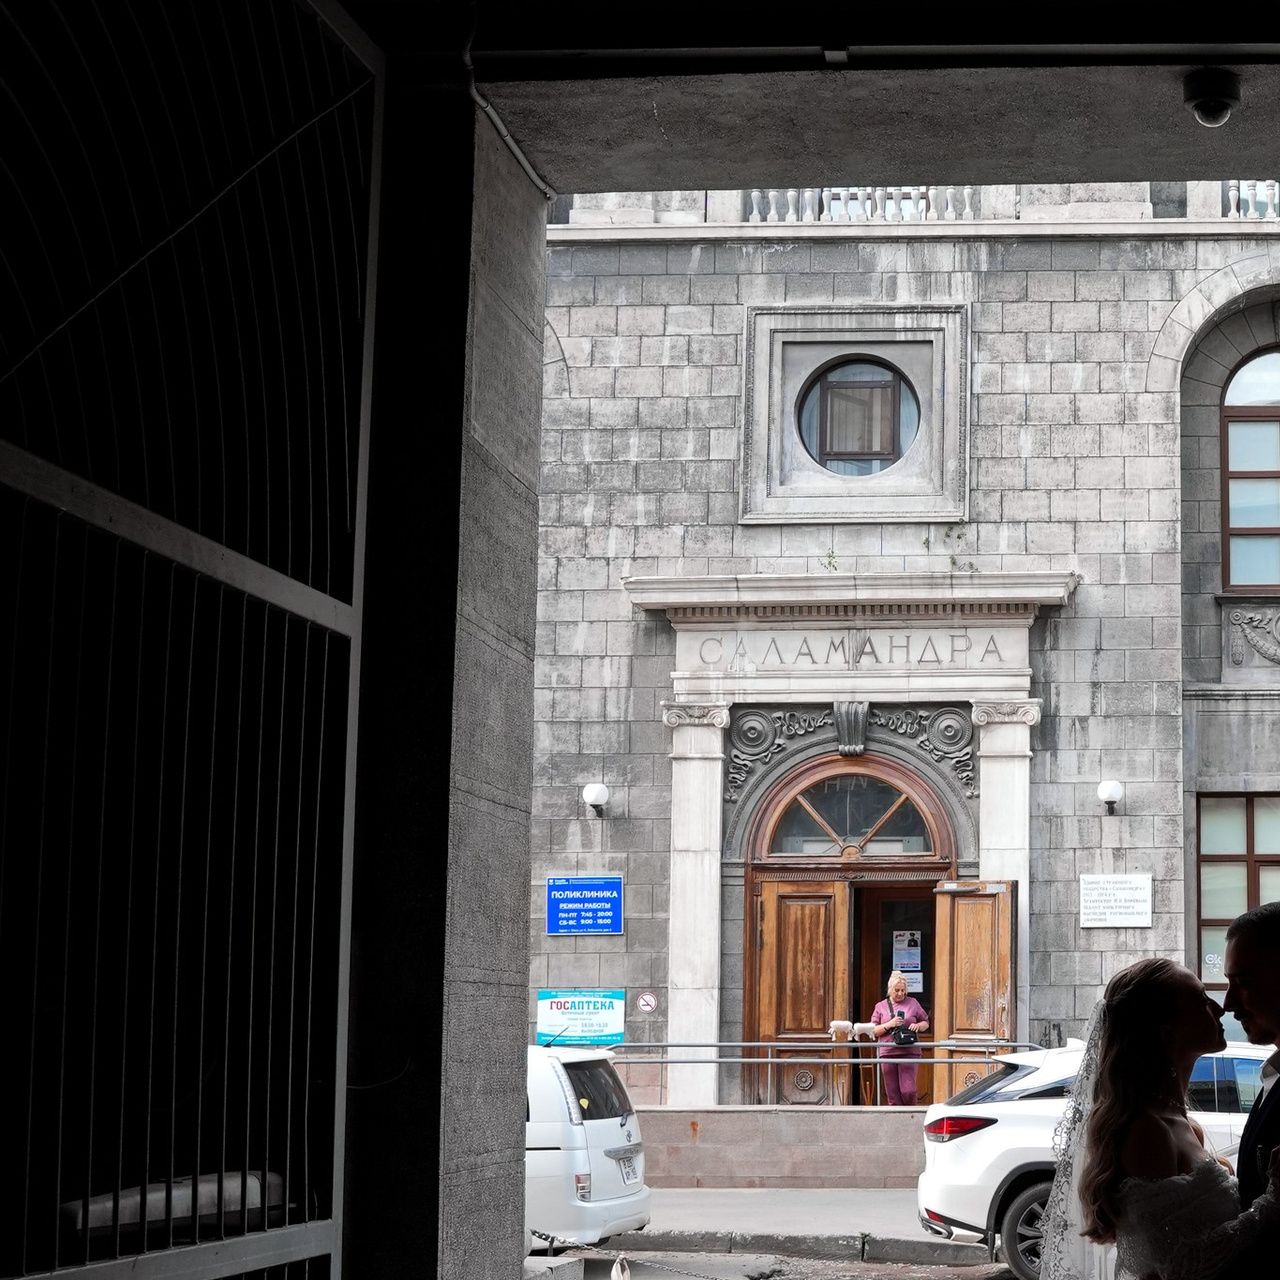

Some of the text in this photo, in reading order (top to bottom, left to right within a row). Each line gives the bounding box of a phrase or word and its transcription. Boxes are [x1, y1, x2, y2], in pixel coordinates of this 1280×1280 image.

[698, 633, 1006, 665] САЛАМАНДРА
[551, 890, 618, 899] ПОЛИКЛИНИКА
[550, 1000, 615, 1010] ГОСАПТЕКА
